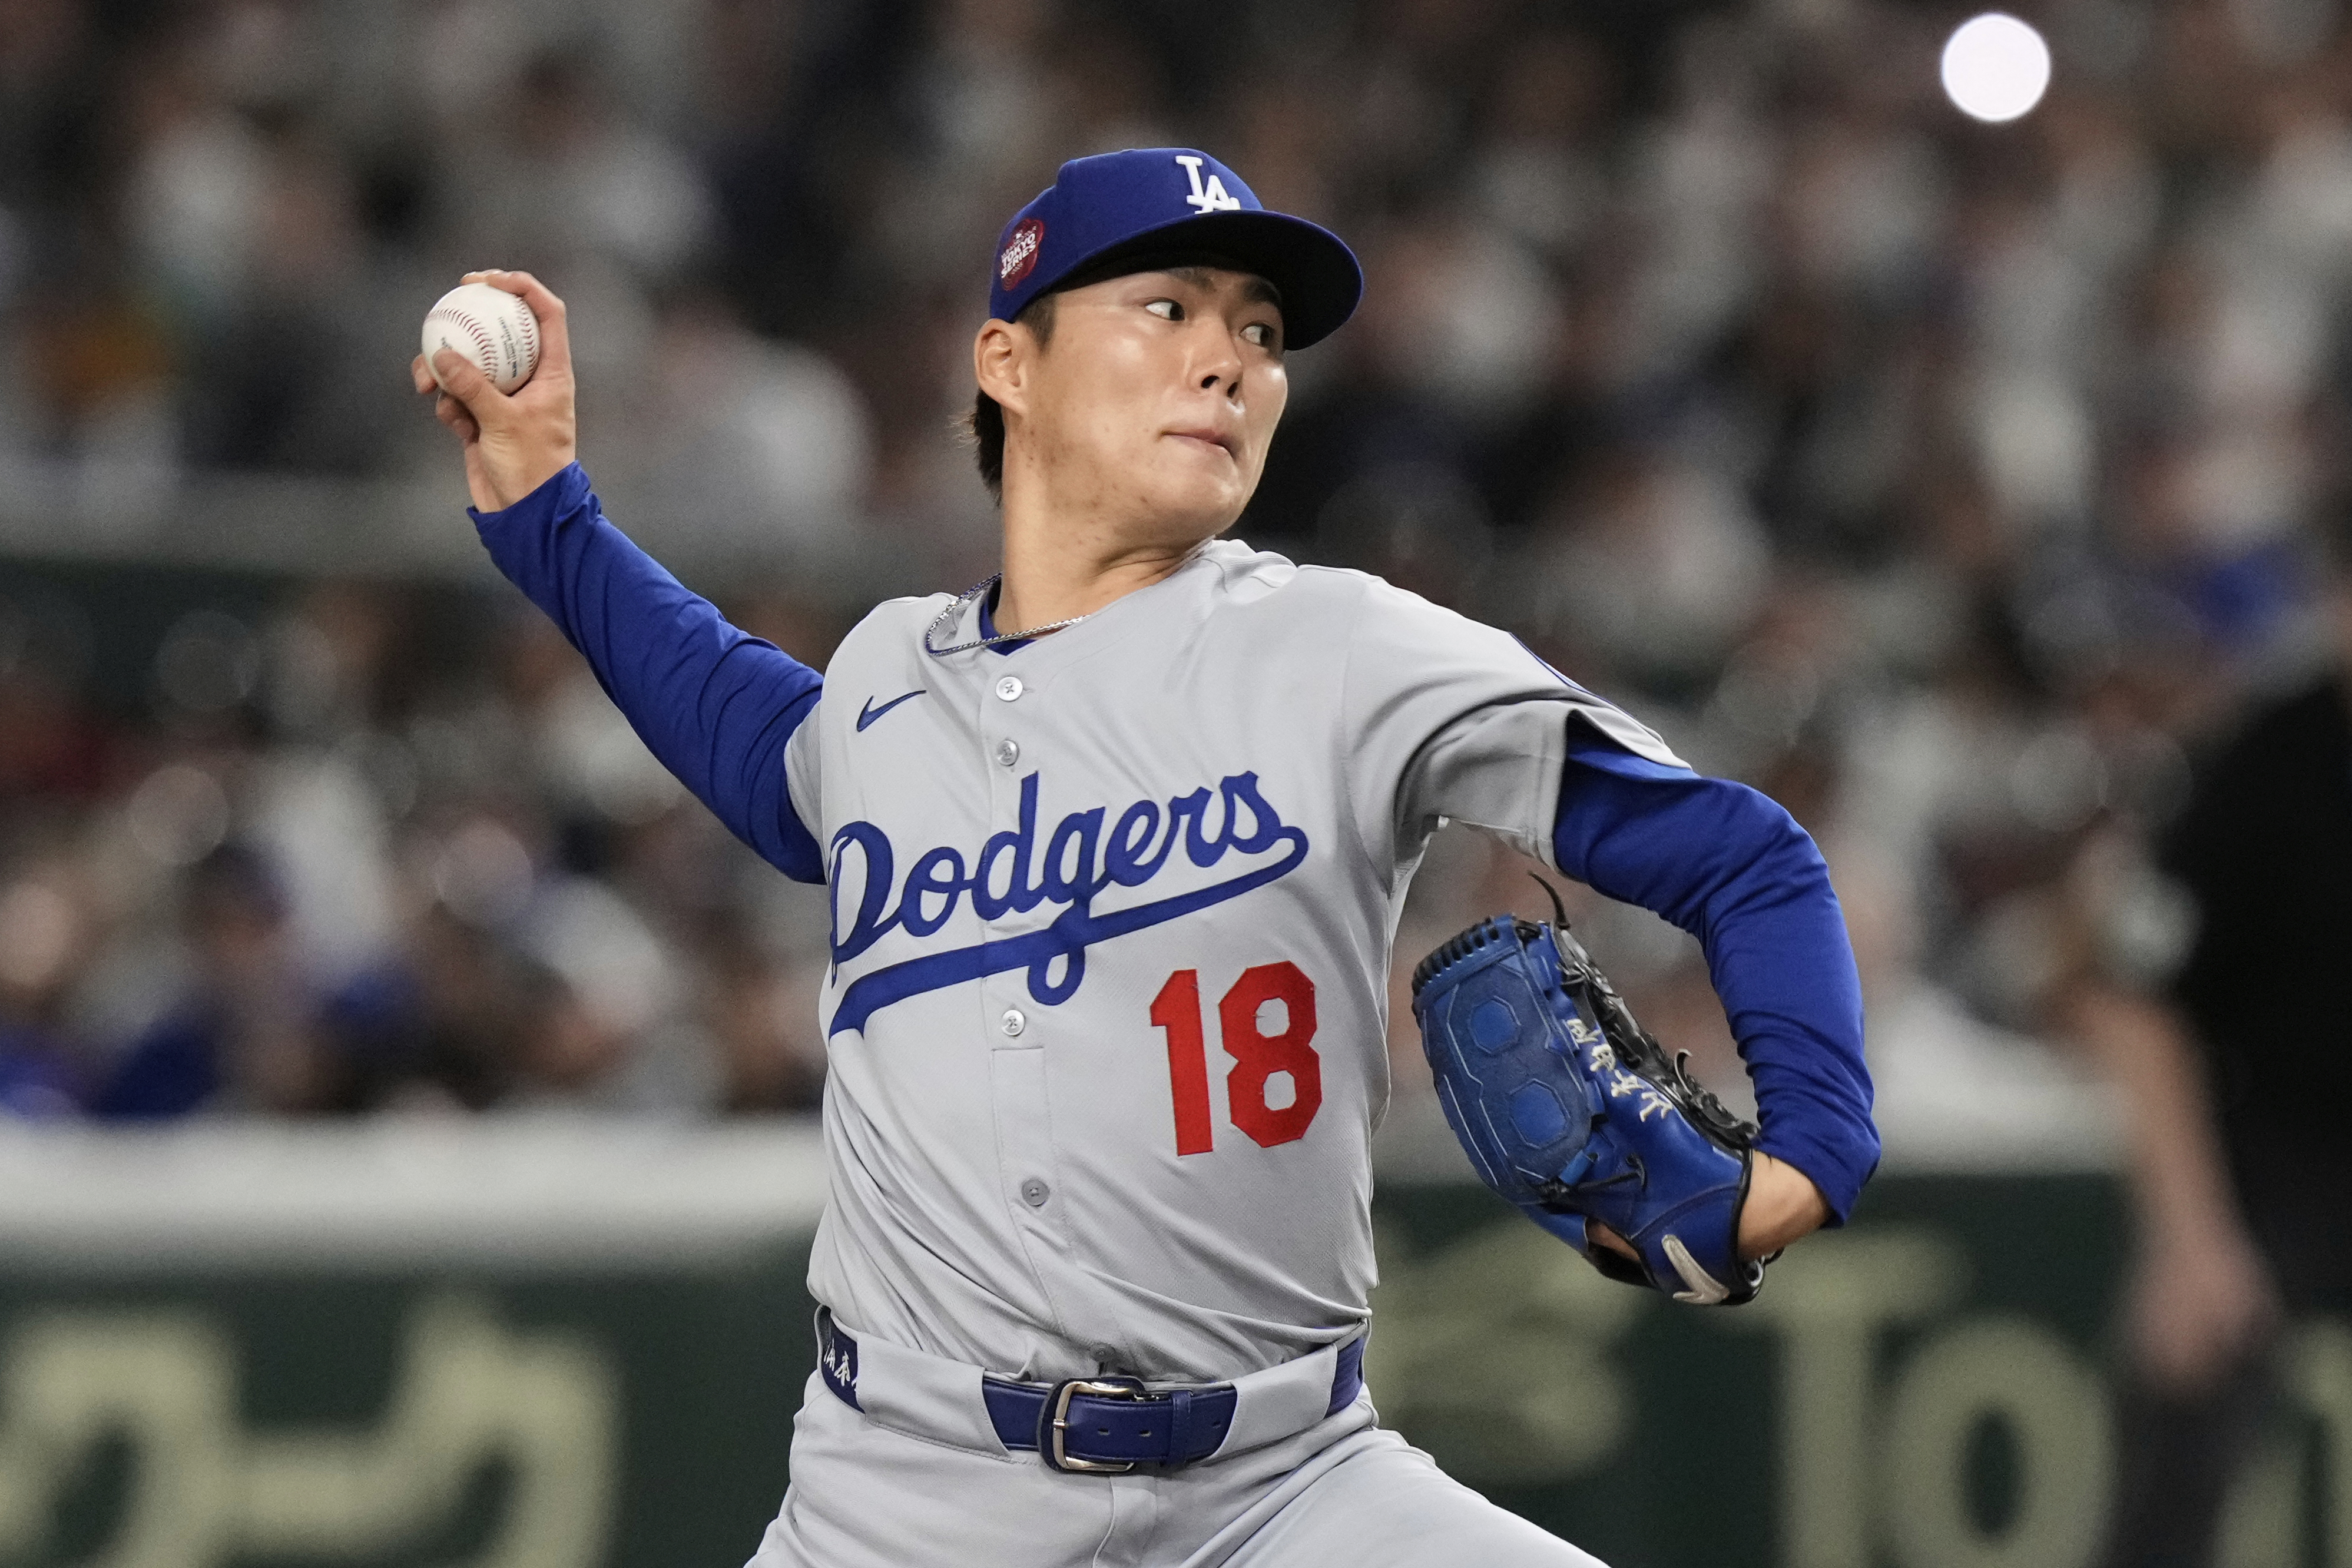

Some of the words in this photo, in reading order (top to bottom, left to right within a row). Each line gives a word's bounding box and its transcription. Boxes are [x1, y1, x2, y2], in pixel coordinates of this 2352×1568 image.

[1175, 155, 1241, 214] LA
[1001, 241, 1036, 279] SERIES
[1002, 233, 1036, 268] TOKYO
[829, 770, 1308, 1040] Dodgers
[1150, 960, 1322, 1156] 18
[1566, 1018, 1673, 1122] 山本由伸
